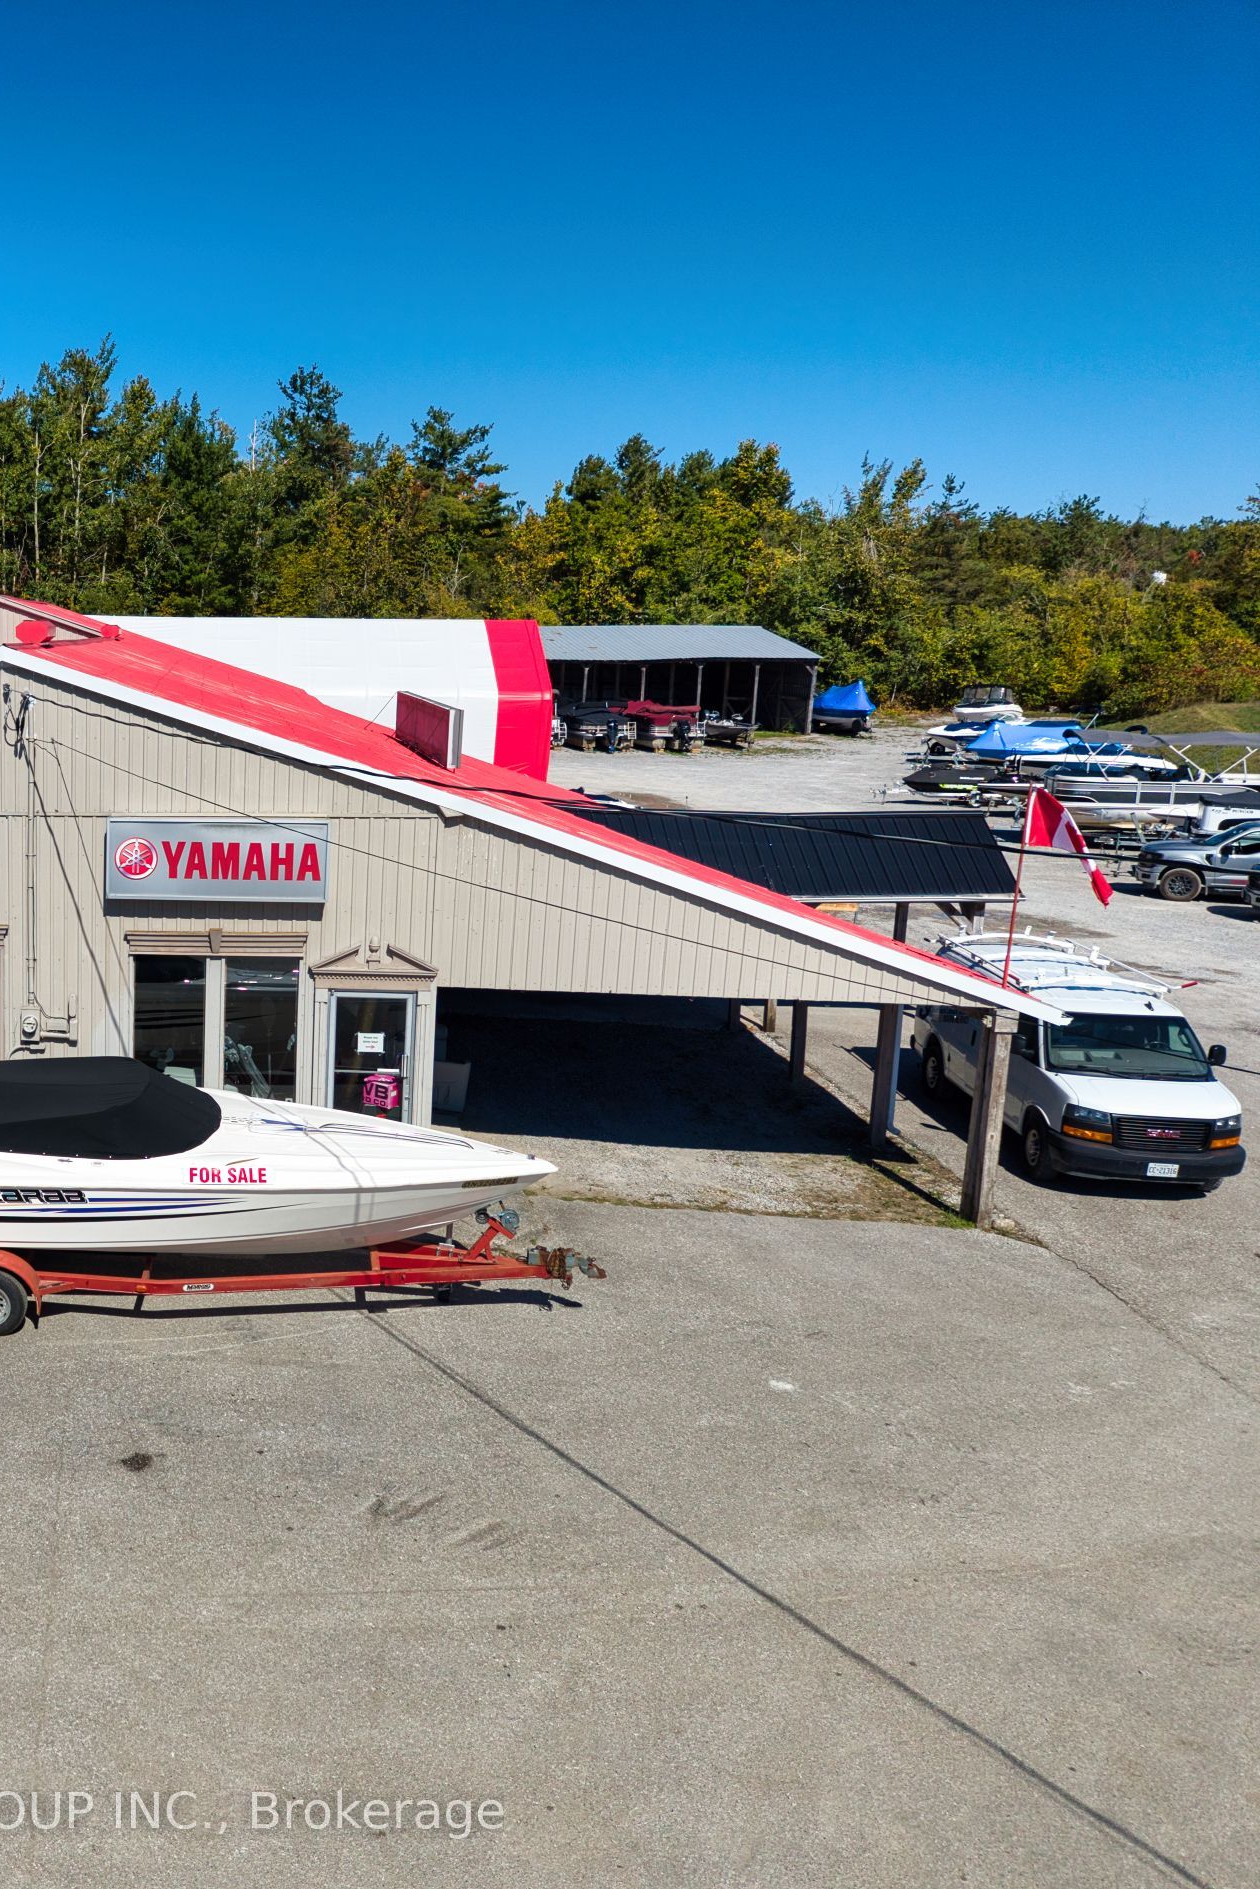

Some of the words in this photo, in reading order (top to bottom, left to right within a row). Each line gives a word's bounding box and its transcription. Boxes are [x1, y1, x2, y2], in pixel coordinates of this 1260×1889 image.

[161, 840, 321, 882] YAMAHA
[189, 1167, 221, 1183] FOR
[227, 1167, 267, 1183] SALE
